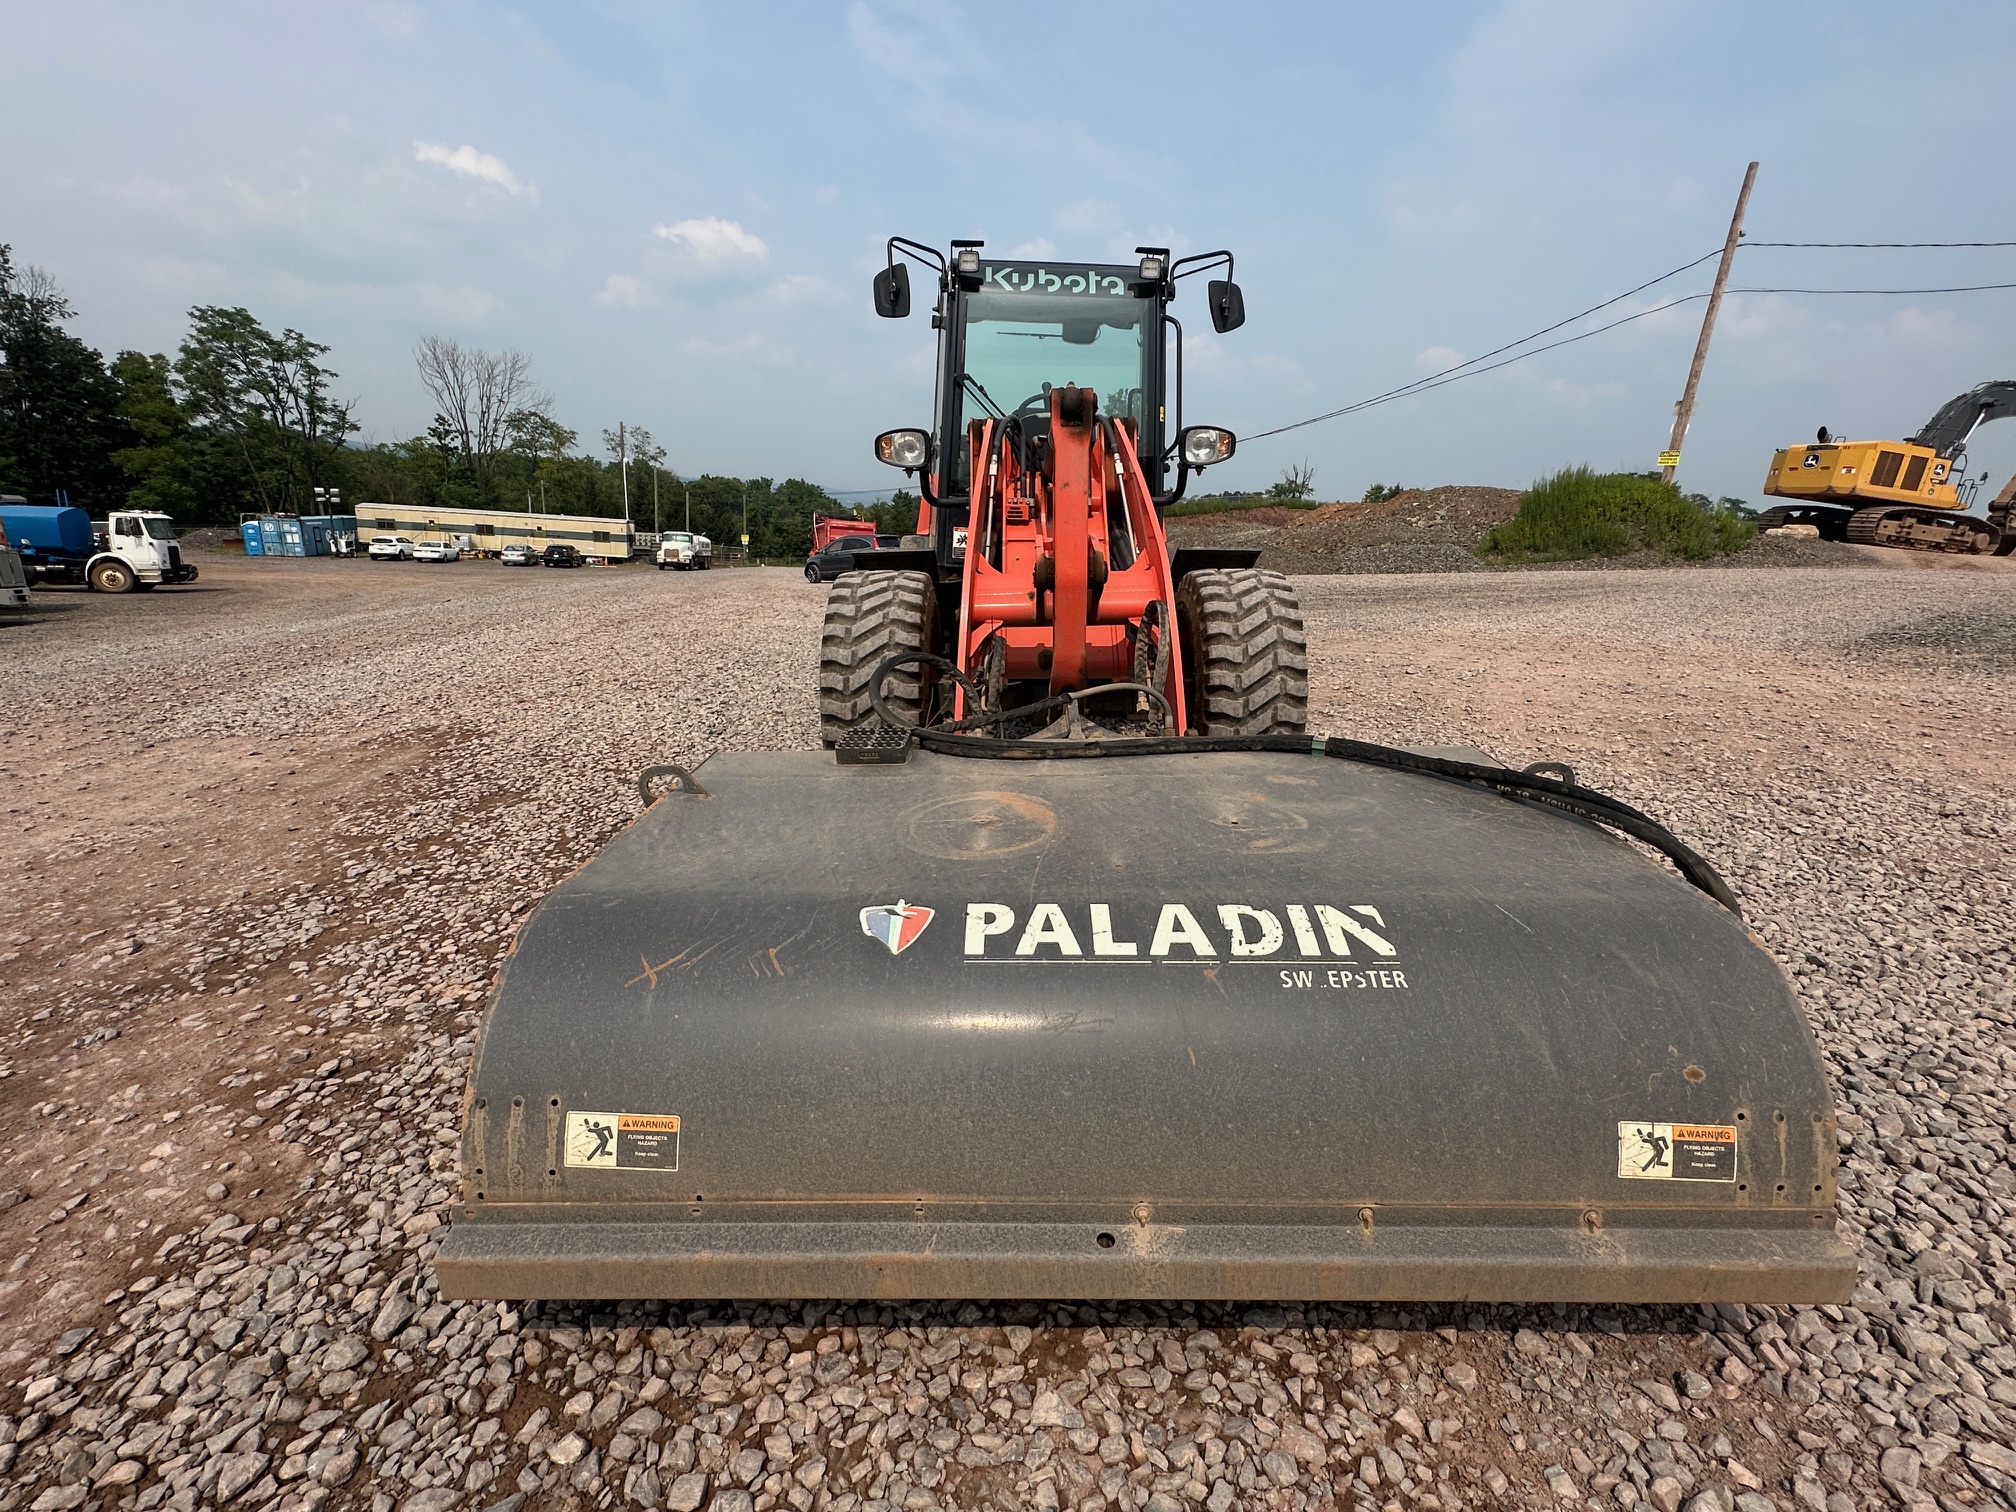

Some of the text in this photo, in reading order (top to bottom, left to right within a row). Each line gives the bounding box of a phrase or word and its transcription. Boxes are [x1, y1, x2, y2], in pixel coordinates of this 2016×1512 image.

[985, 266, 1125, 296] Kubota
[964, 903, 1397, 956] PALADIN
[1280, 970, 1409, 989] SWEPSTER
[631, 1119, 674, 1129] WARNING
[1686, 1129, 1731, 1140] WARNING
